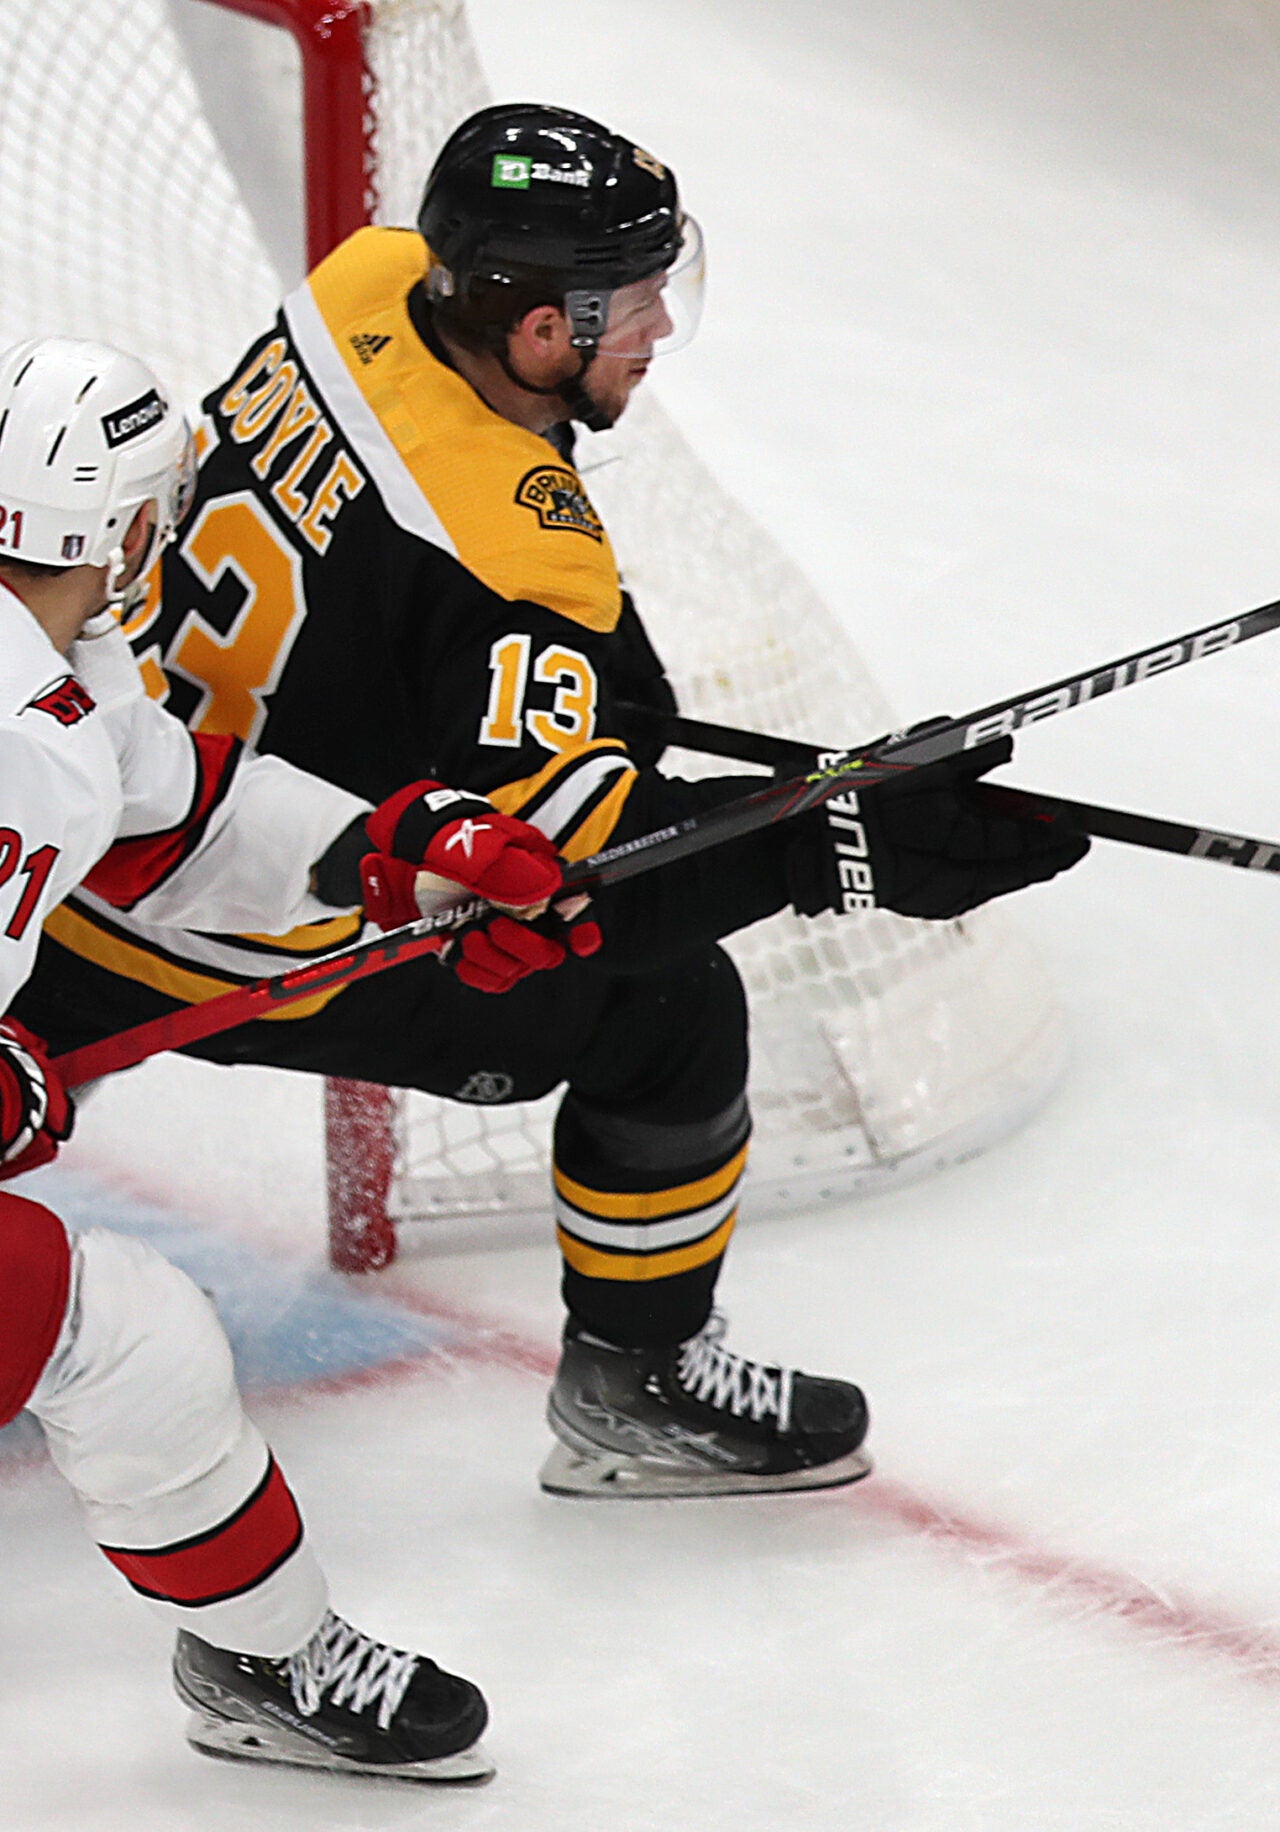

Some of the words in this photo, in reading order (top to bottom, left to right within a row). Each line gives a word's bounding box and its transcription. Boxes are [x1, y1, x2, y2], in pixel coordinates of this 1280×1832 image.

[531, 162, 590, 188] Bank
[220, 336, 366, 557] COYLE
[477, 632, 599, 754] 13
